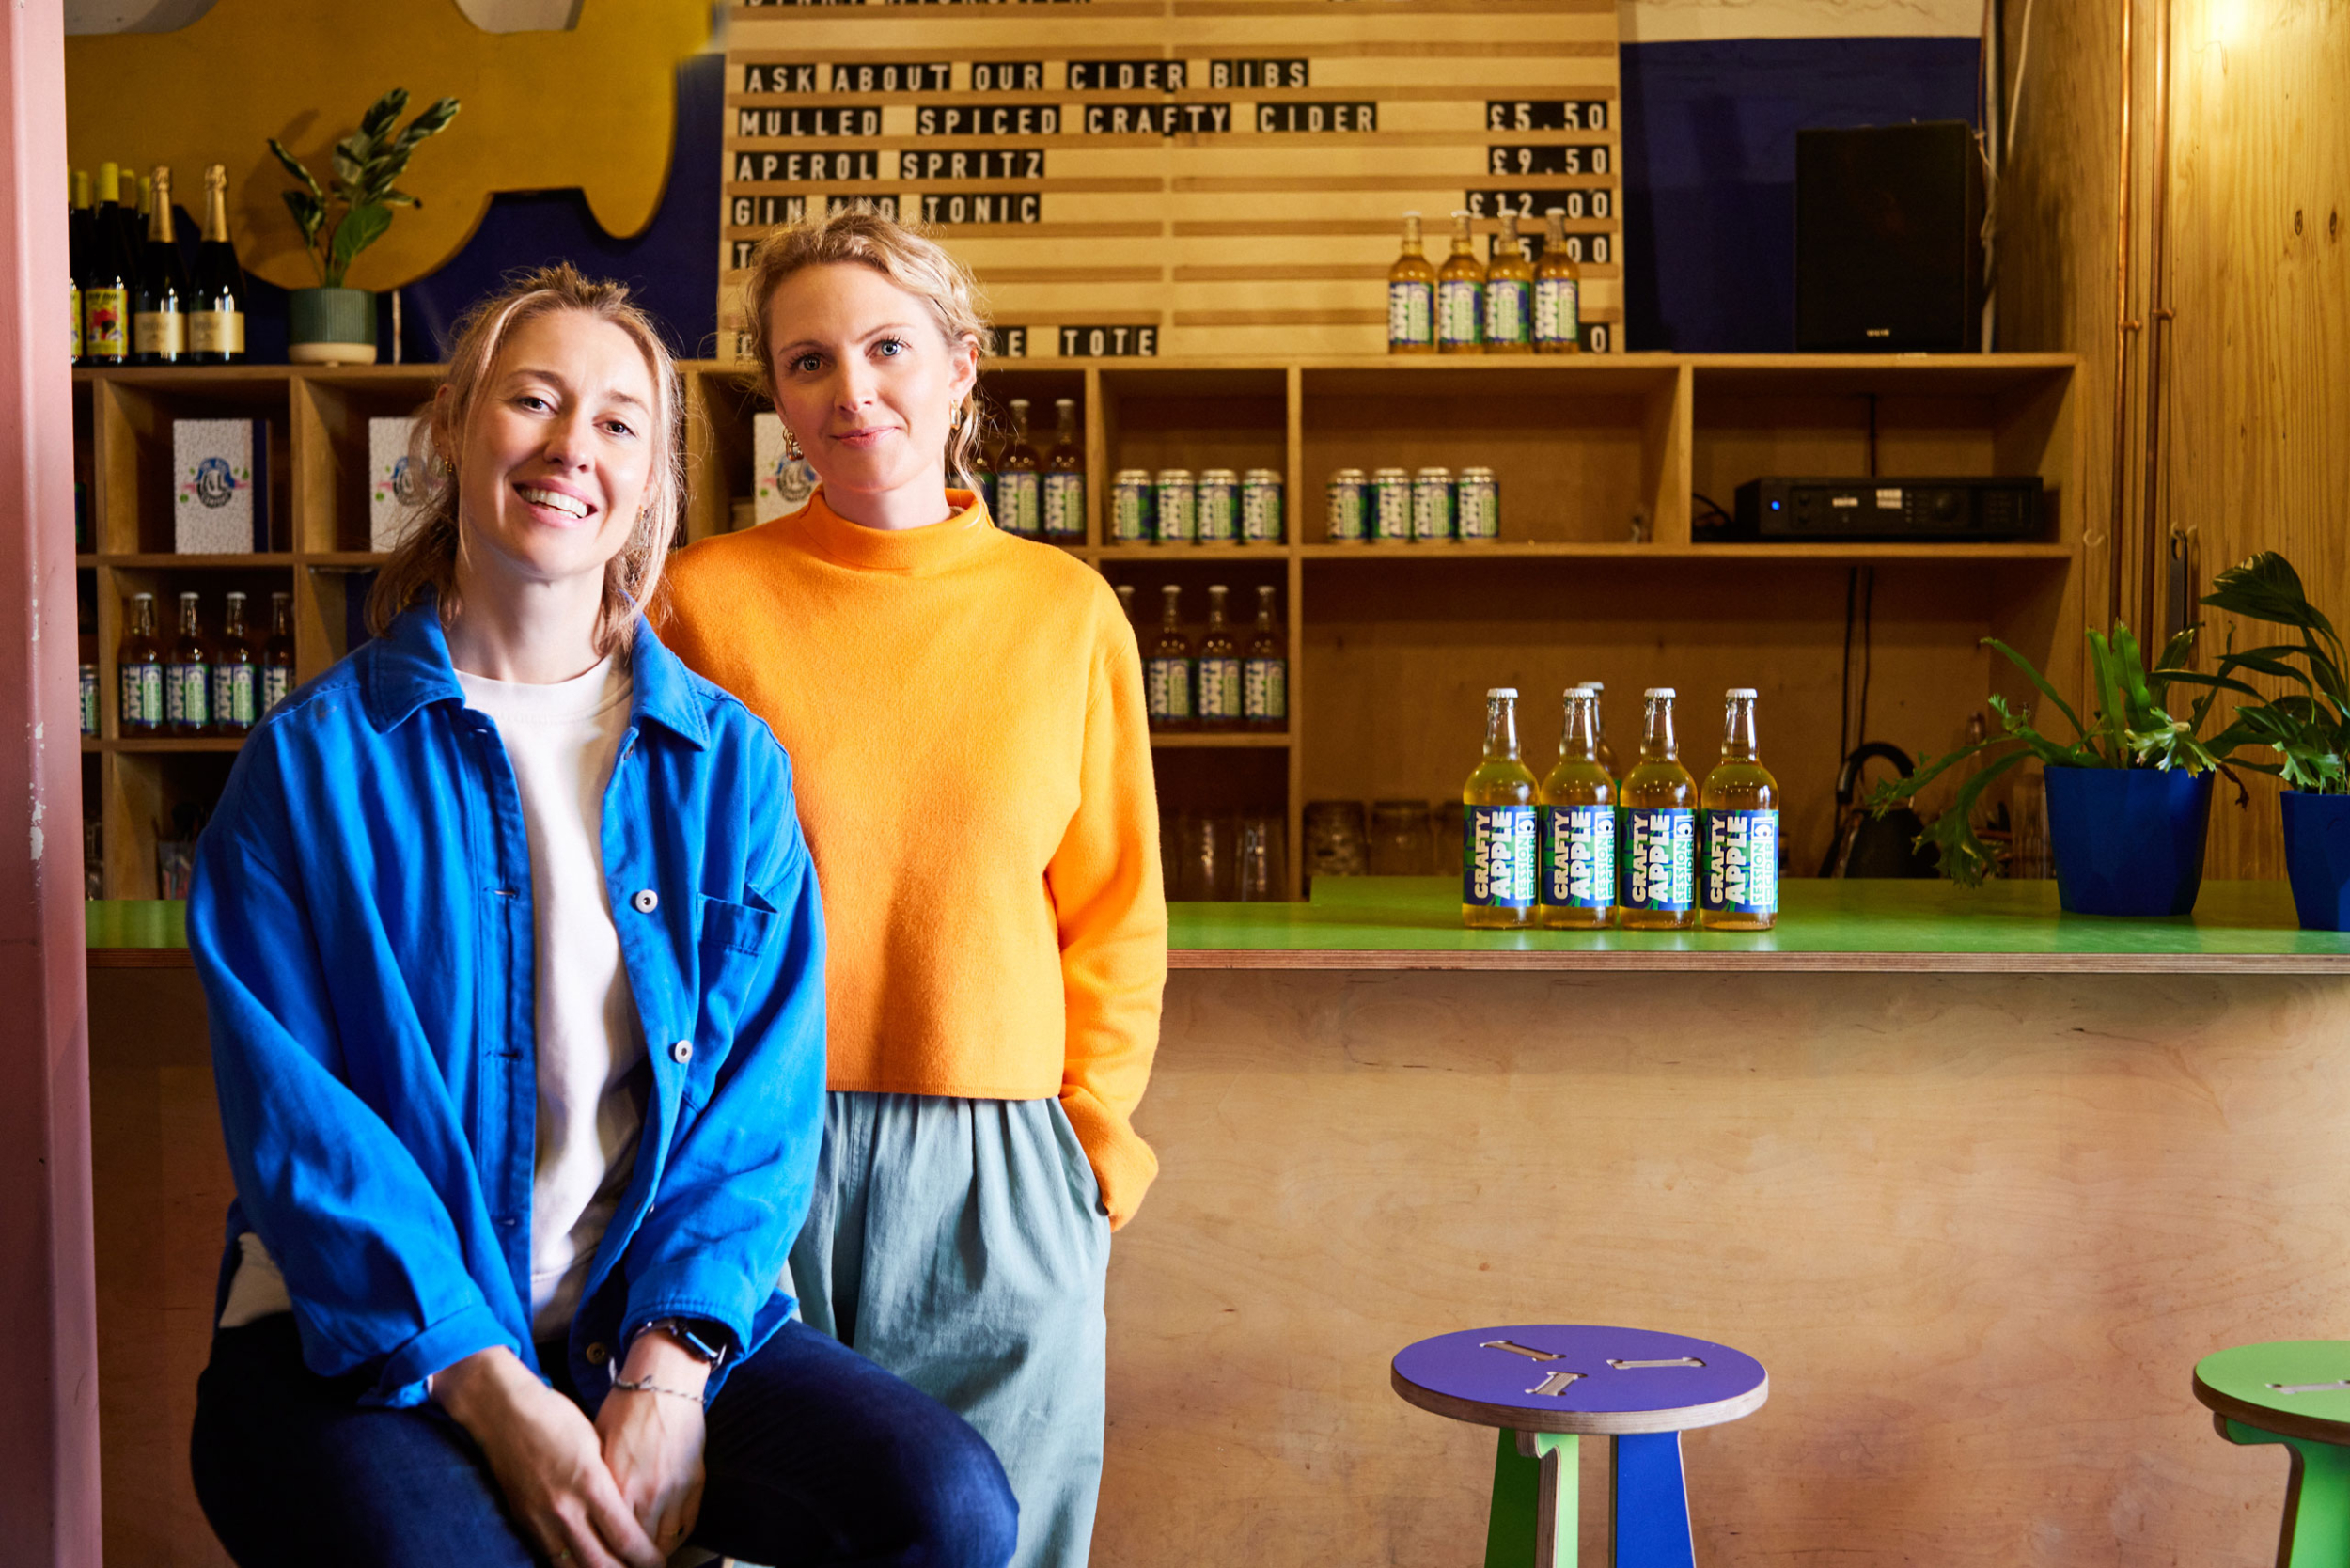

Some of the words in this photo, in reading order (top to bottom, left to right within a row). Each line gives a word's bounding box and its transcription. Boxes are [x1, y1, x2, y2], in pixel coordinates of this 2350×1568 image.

[747, 67, 814, 92] ASK
[834, 65, 950, 91] ABOUT
[975, 65, 1041, 91] OUR
[1070, 63, 1184, 90] CIDER
[1213, 61, 1306, 88] BIBS
[740, 109, 879, 135] MULLED
[919, 108, 1058, 134] SPICED
[1088, 104, 1228, 133] CRAFTY
[1260, 105, 1373, 132] CIDER
[1490, 103, 1605, 130] £5.50
[738, 153, 877, 180] APEROL
[902, 152, 1042, 179] SPRITZ
[1491, 148, 1607, 174] £9.50
[734, 199, 805, 226] GIN
[926, 196, 1038, 223] TONIC
[1470, 192, 1608, 218] £1200
[1062, 329, 1153, 356] TOTE
[1474, 811, 1490, 899] CRAFTY
[1490, 811, 1512, 900] APPLE
[1518, 838, 1528, 897] SESSION
[1554, 812, 1569, 899] CRAFTY
[1570, 811, 1590, 900] APPLE
[1598, 838, 1606, 898] SESSION
[1632, 814, 1648, 902] CRAFTY
[1648, 814, 1669, 903] APPLE
[1676, 841, 1685, 901] SESSION
[1710, 816, 1725, 903] CRAFTY
[1725, 816, 1747, 905] APPLE
[1753, 842, 1763, 902] SESSION
